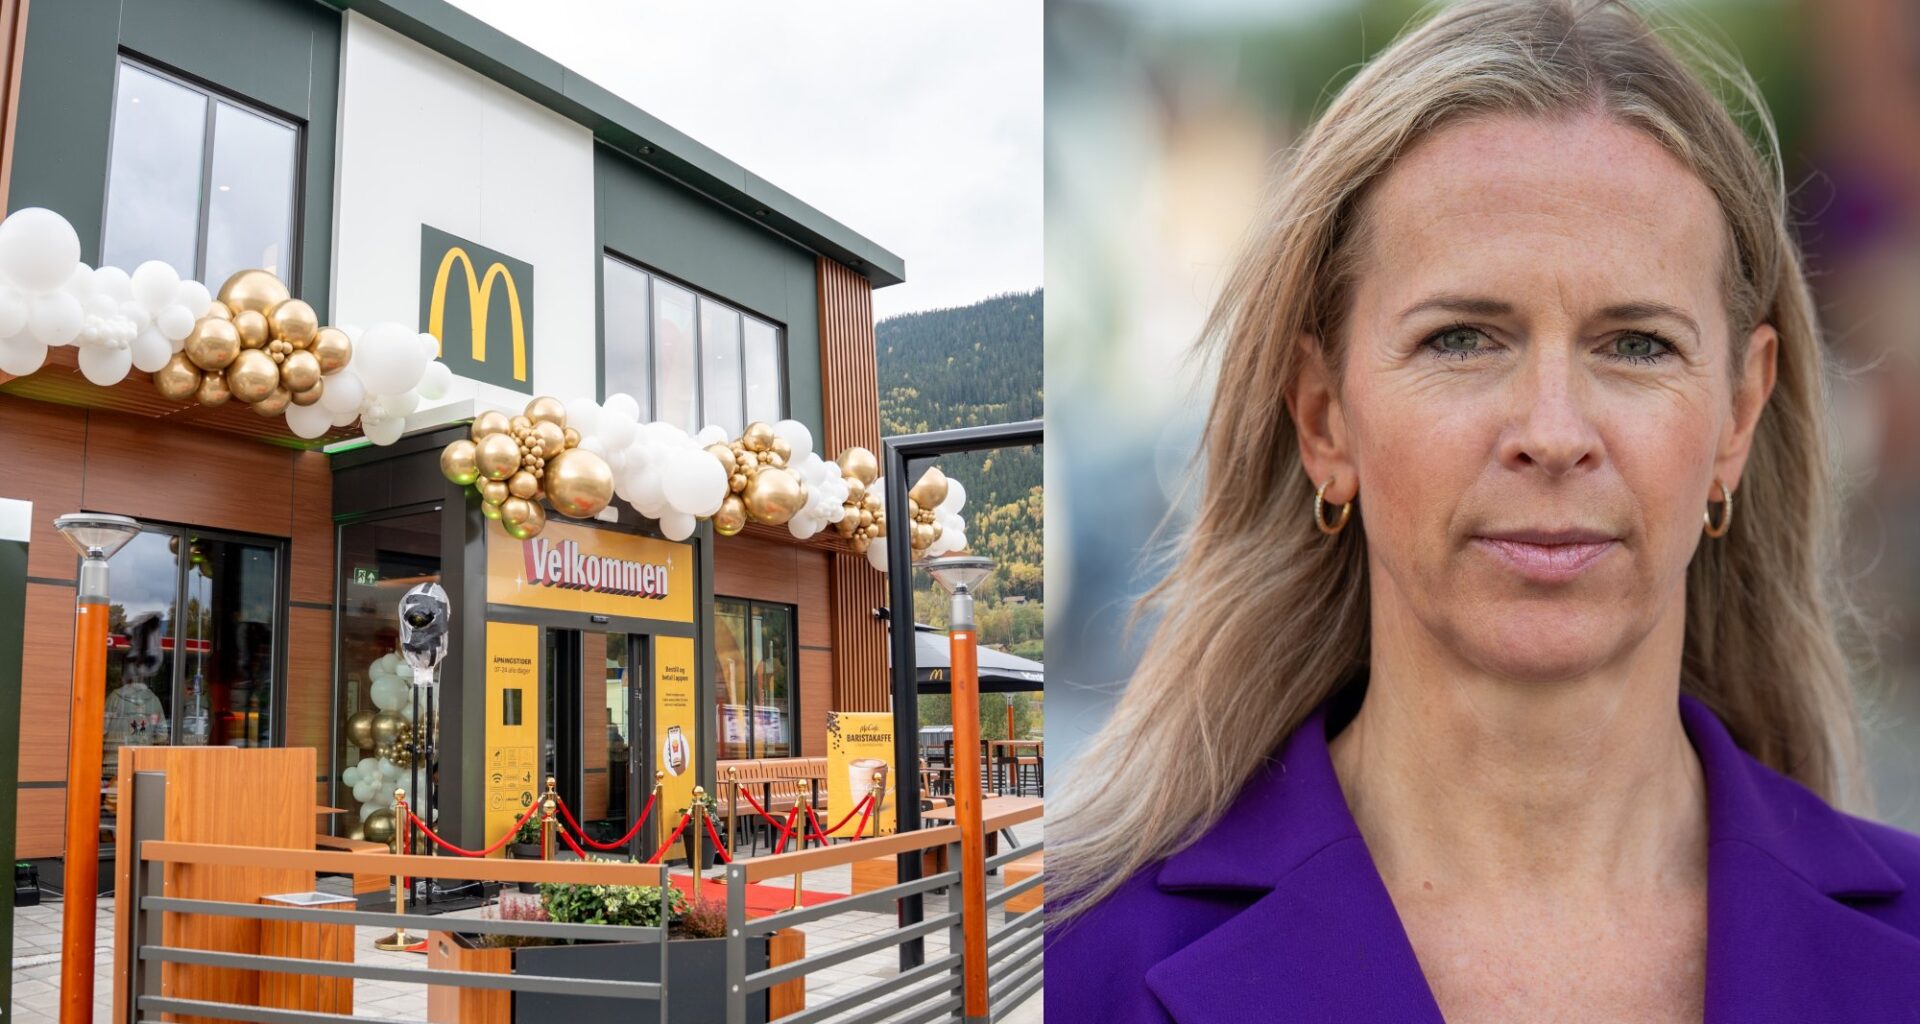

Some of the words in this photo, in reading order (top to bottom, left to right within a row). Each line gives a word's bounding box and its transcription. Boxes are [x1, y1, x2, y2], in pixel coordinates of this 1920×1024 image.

[428, 247, 526, 382] M
[524, 537, 668, 599] Velkommen
[494, 655, 531, 664] ÅPNINGSTIDER
[847, 733, 891, 742] BARISTAKAFFE
